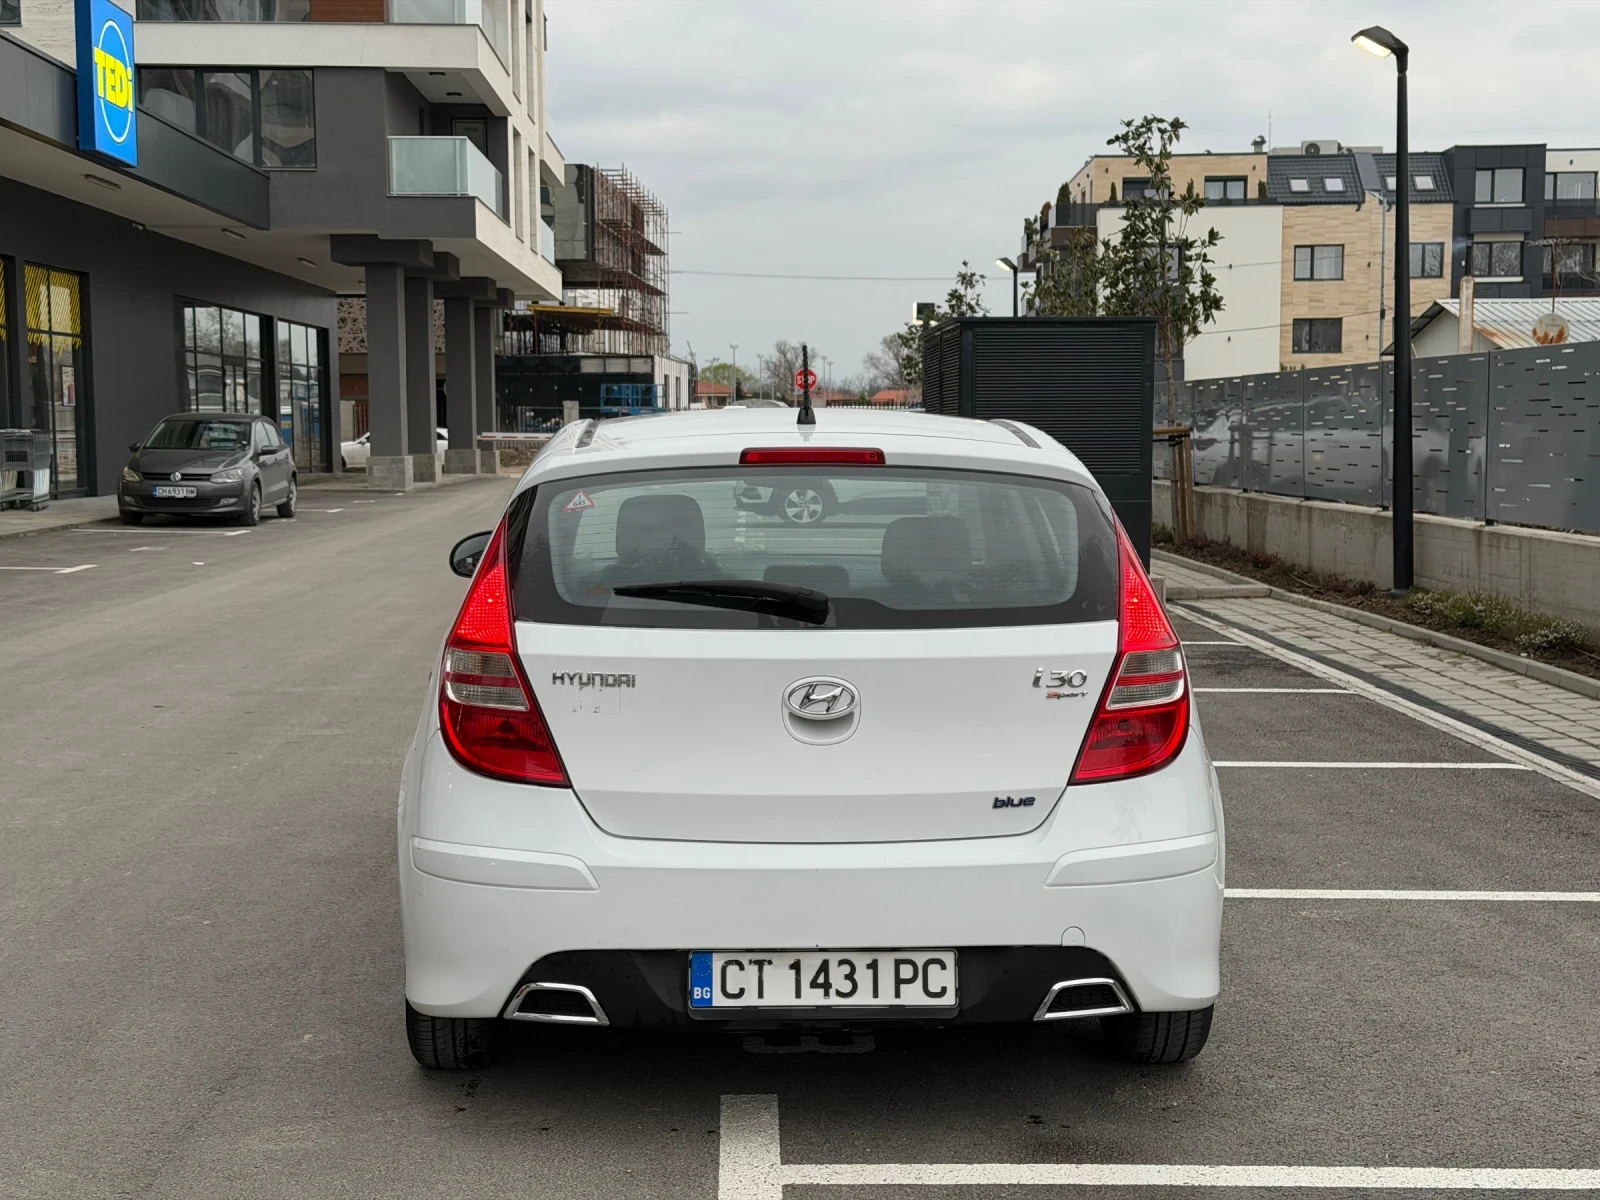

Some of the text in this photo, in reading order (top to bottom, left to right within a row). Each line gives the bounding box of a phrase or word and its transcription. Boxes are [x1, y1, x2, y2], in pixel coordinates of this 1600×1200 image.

[94, 46, 134, 113] TEDi
[552, 671, 636, 688] HYUNDAI
[992, 795, 1036, 809] blue
[720, 957, 948, 1000] CT 1431 PC
[693, 986, 711, 999] BG
